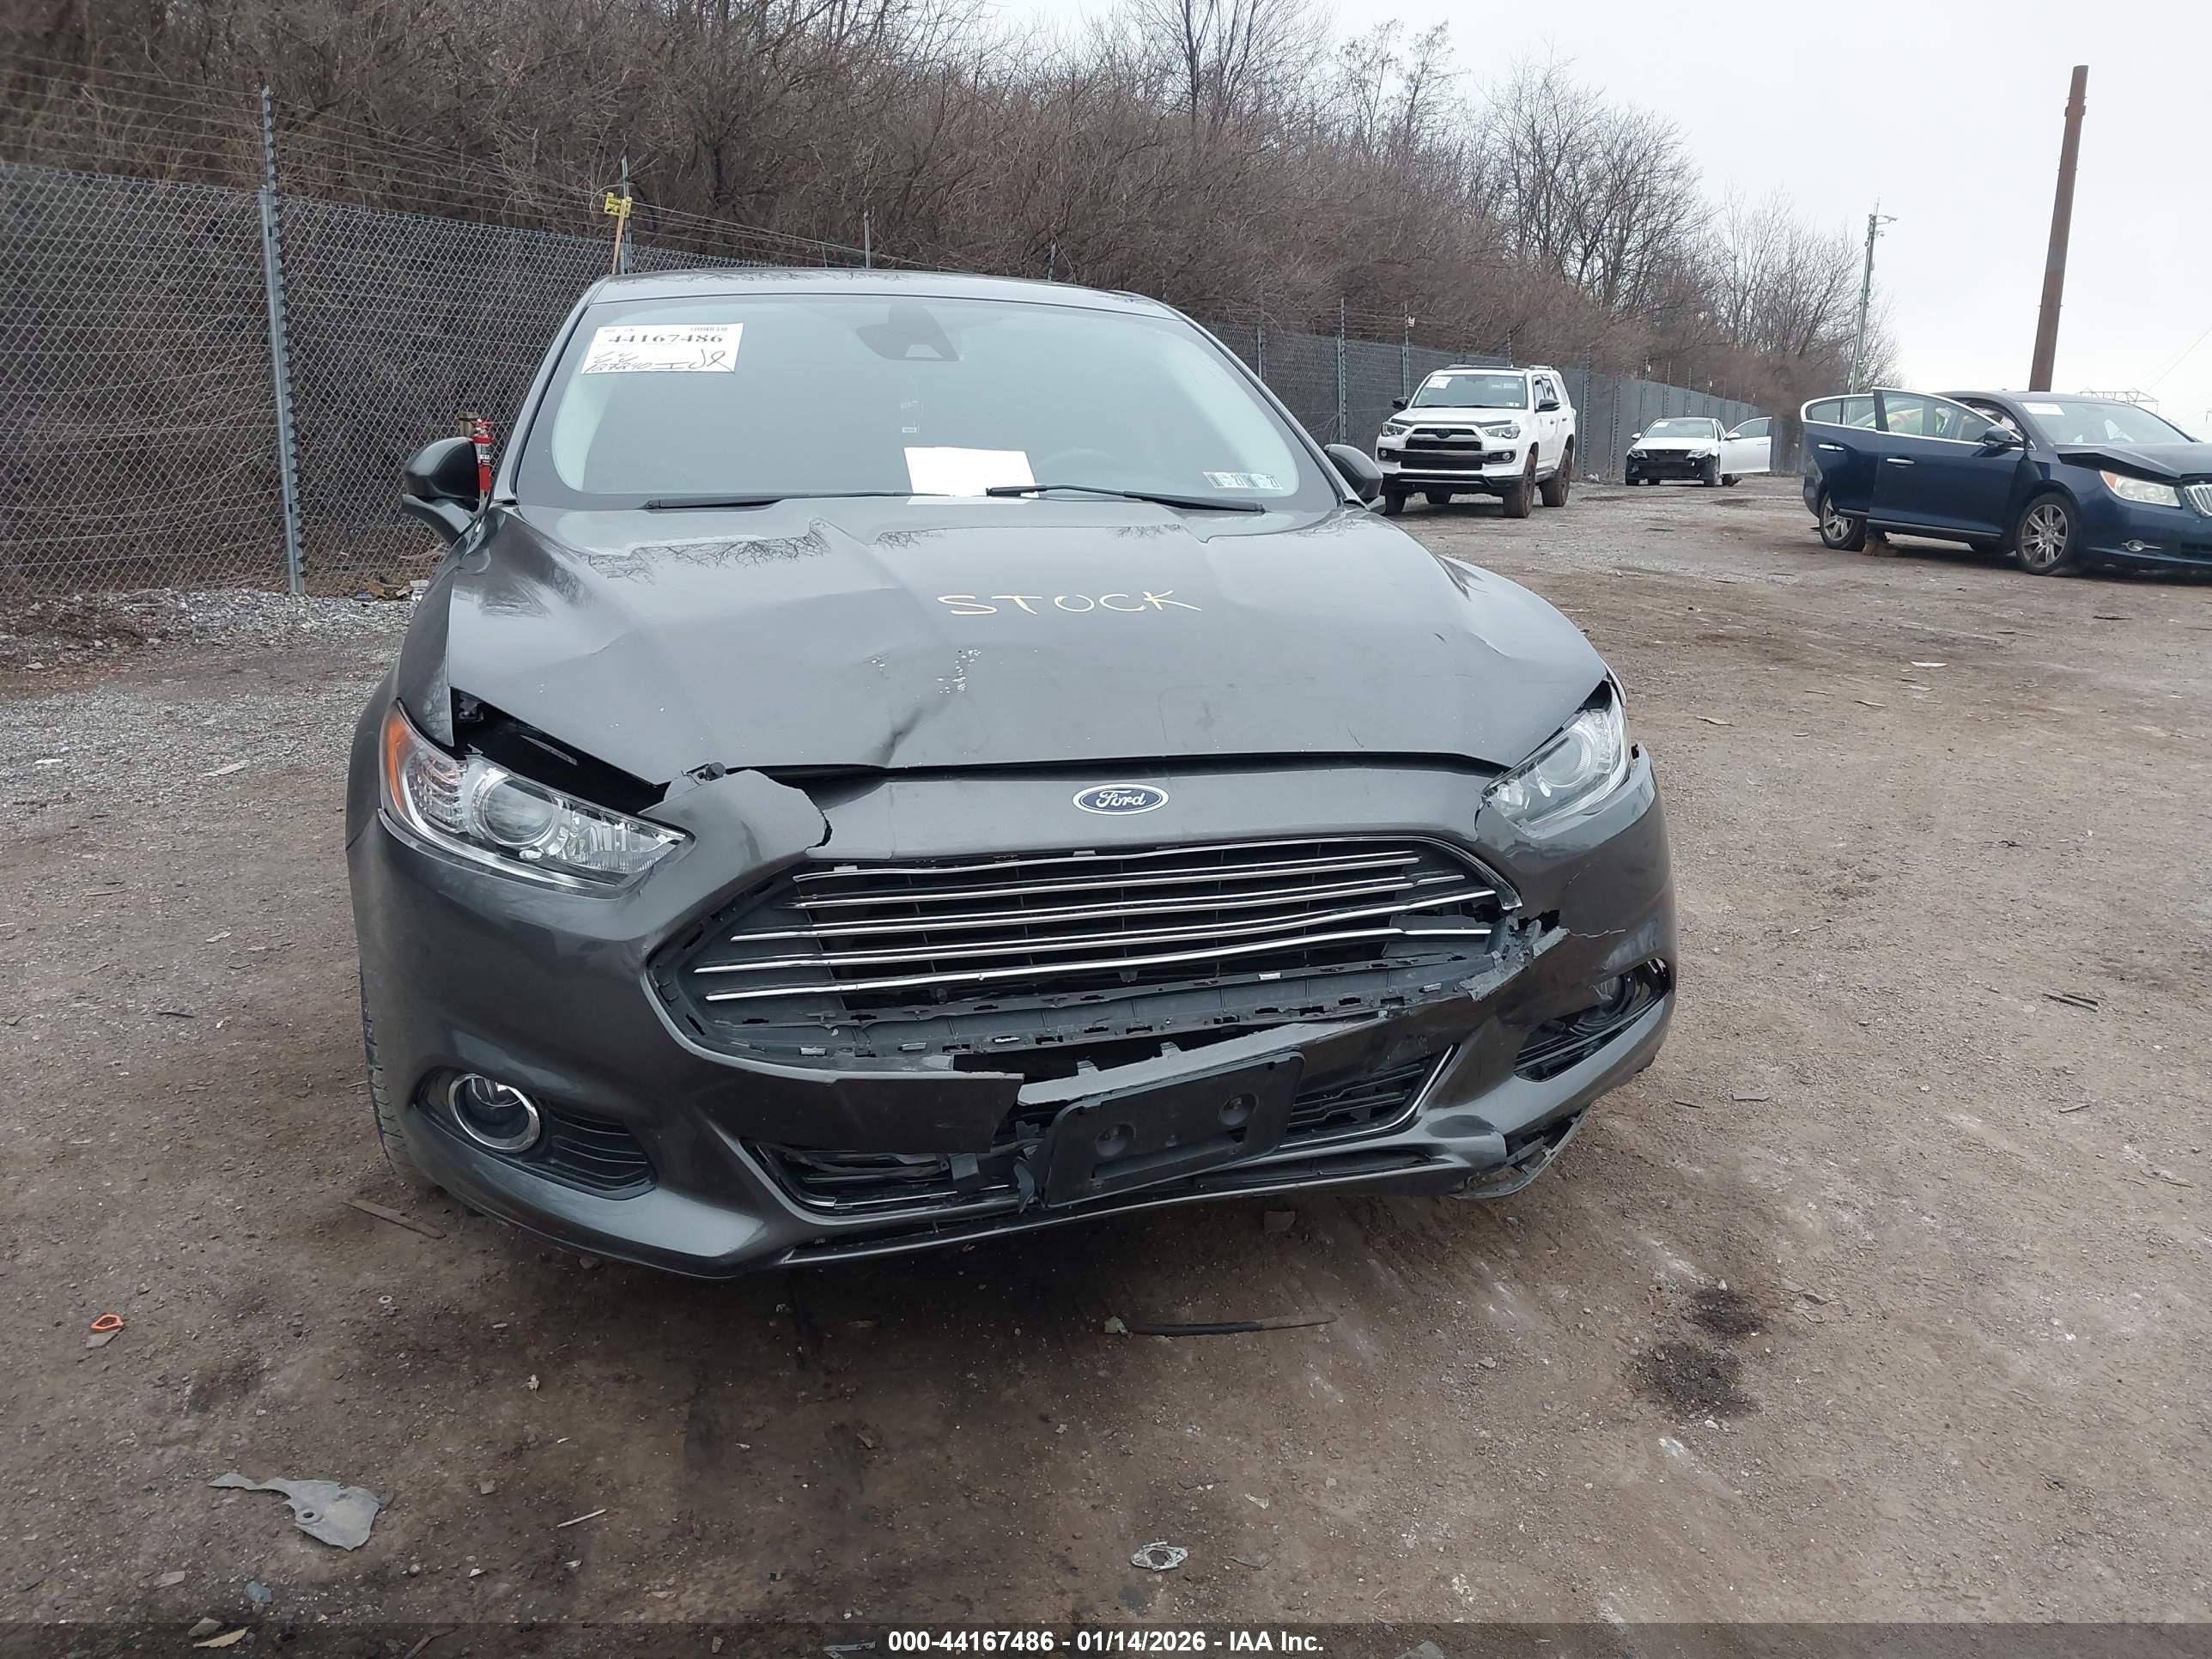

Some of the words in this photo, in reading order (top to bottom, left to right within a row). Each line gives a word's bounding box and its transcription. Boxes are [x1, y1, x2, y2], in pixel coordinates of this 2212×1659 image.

[608, 334, 723, 343] 44167486
[937, 589, 1203, 616] STOCK
[1096, 790, 1146, 808] Ford
